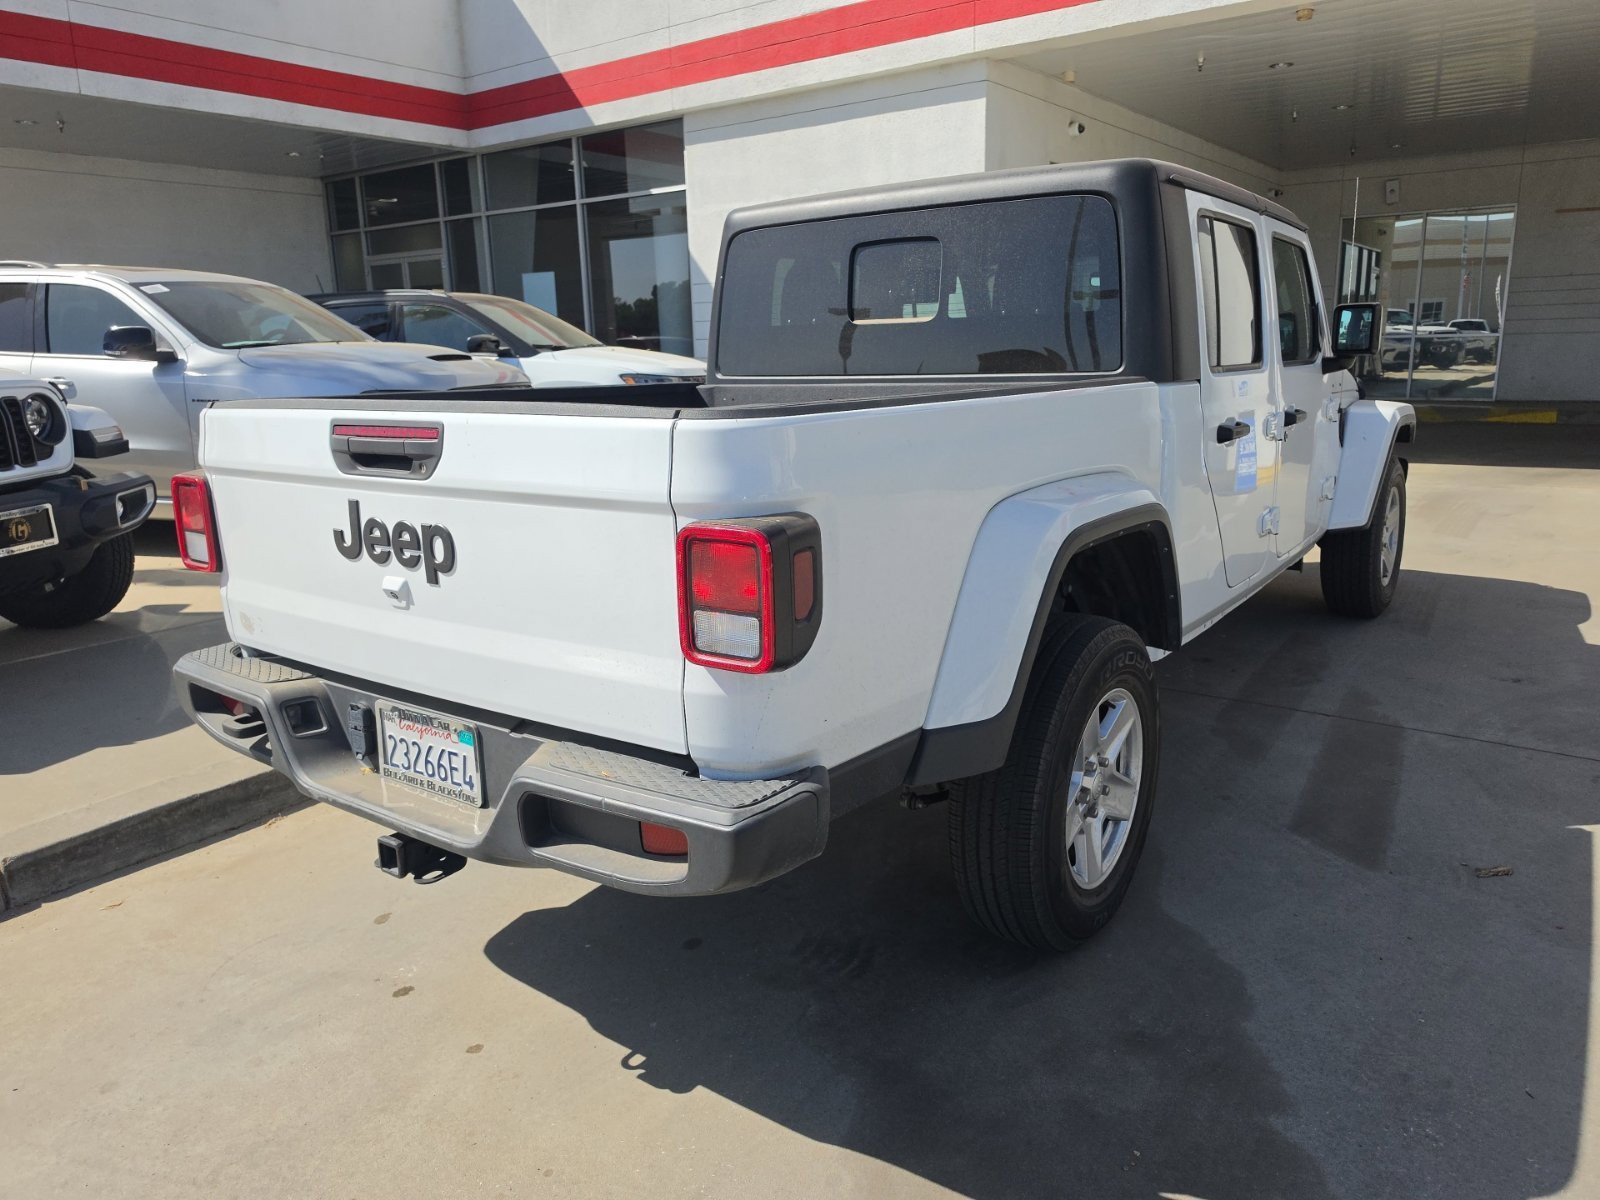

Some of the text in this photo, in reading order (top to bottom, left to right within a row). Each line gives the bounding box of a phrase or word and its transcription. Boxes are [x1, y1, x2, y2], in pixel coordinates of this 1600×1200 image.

[333, 499, 456, 585] Jeep
[387, 734, 475, 791] 23266E4
[426, 779, 479, 806] BLACKSTONE
